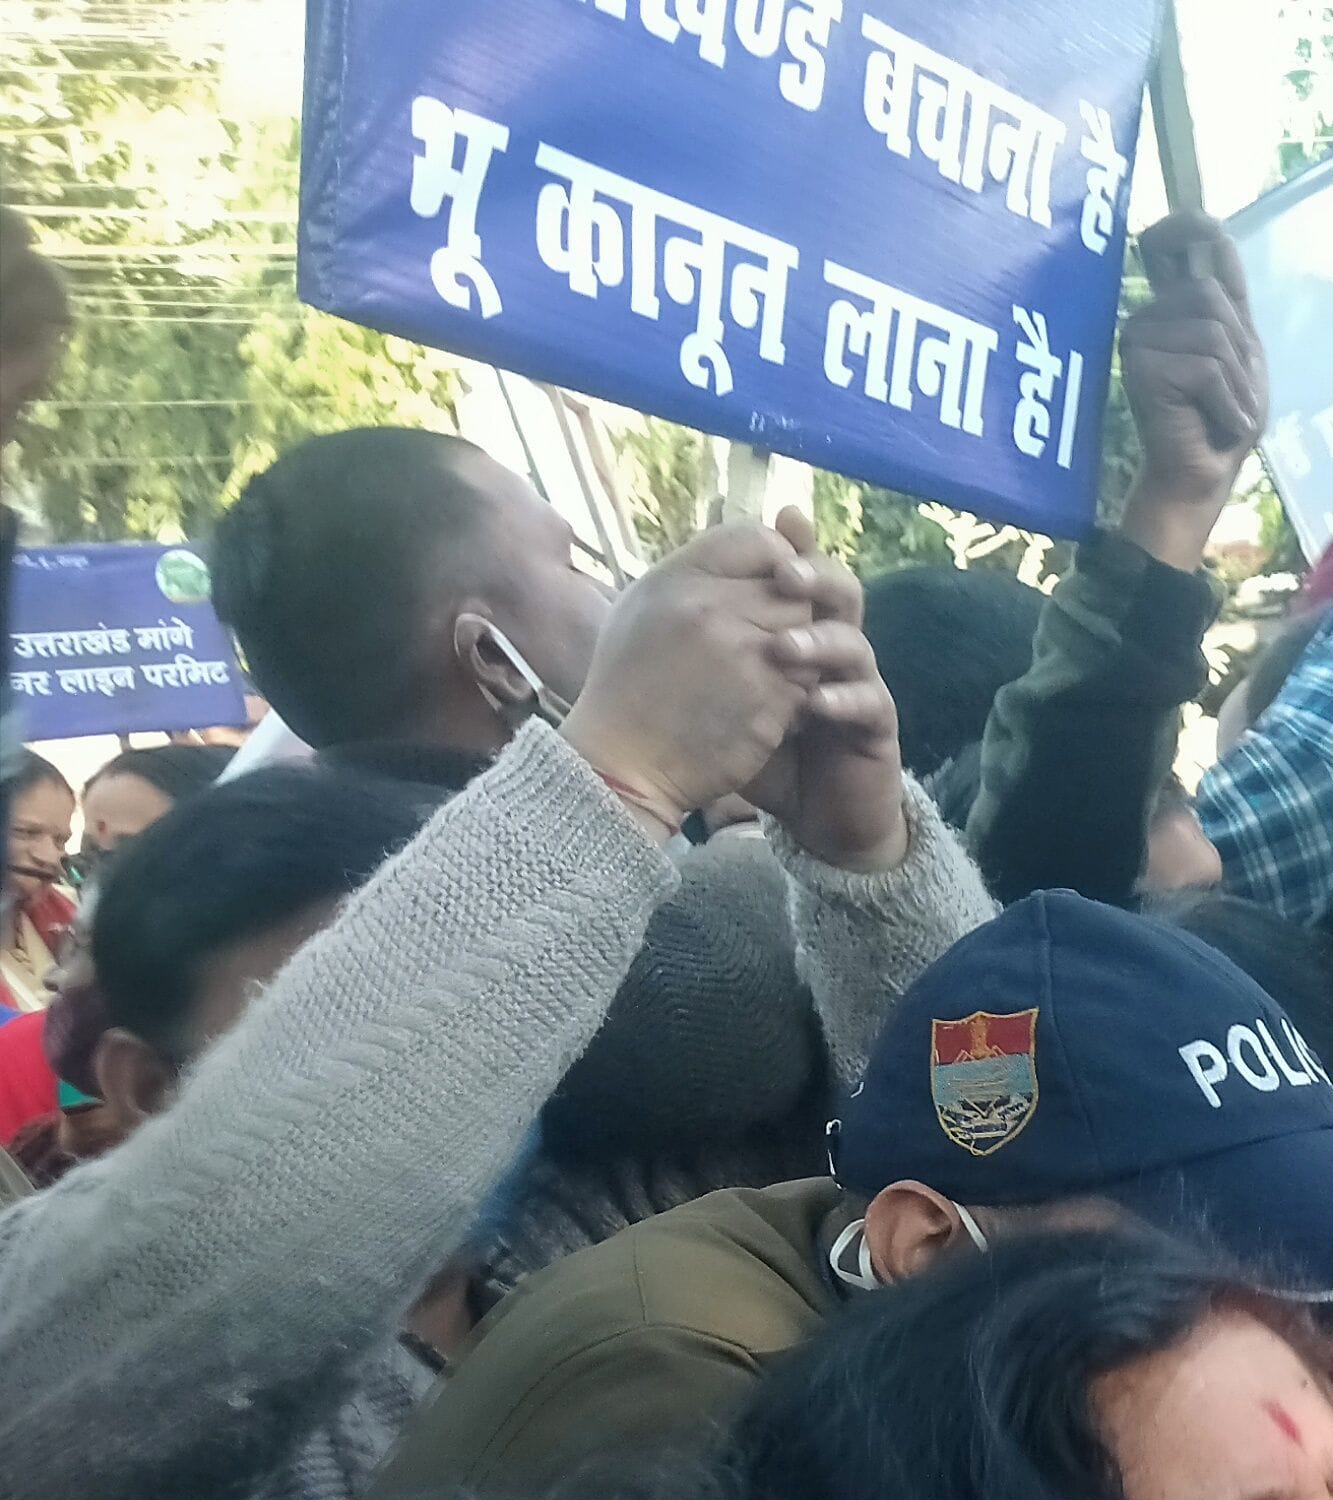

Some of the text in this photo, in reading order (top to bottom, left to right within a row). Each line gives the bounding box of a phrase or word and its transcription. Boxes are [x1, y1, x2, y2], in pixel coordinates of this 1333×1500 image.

[859, 13, 1066, 229] बचाना
[1079, 99, 1127, 256] है
[410, 96, 510, 319] भू
[535, 141, 800, 397] कानून
[821, 262, 999, 437] लाना
[10, 671, 52, 696] नर
[55, 666, 135, 697] लाइन
